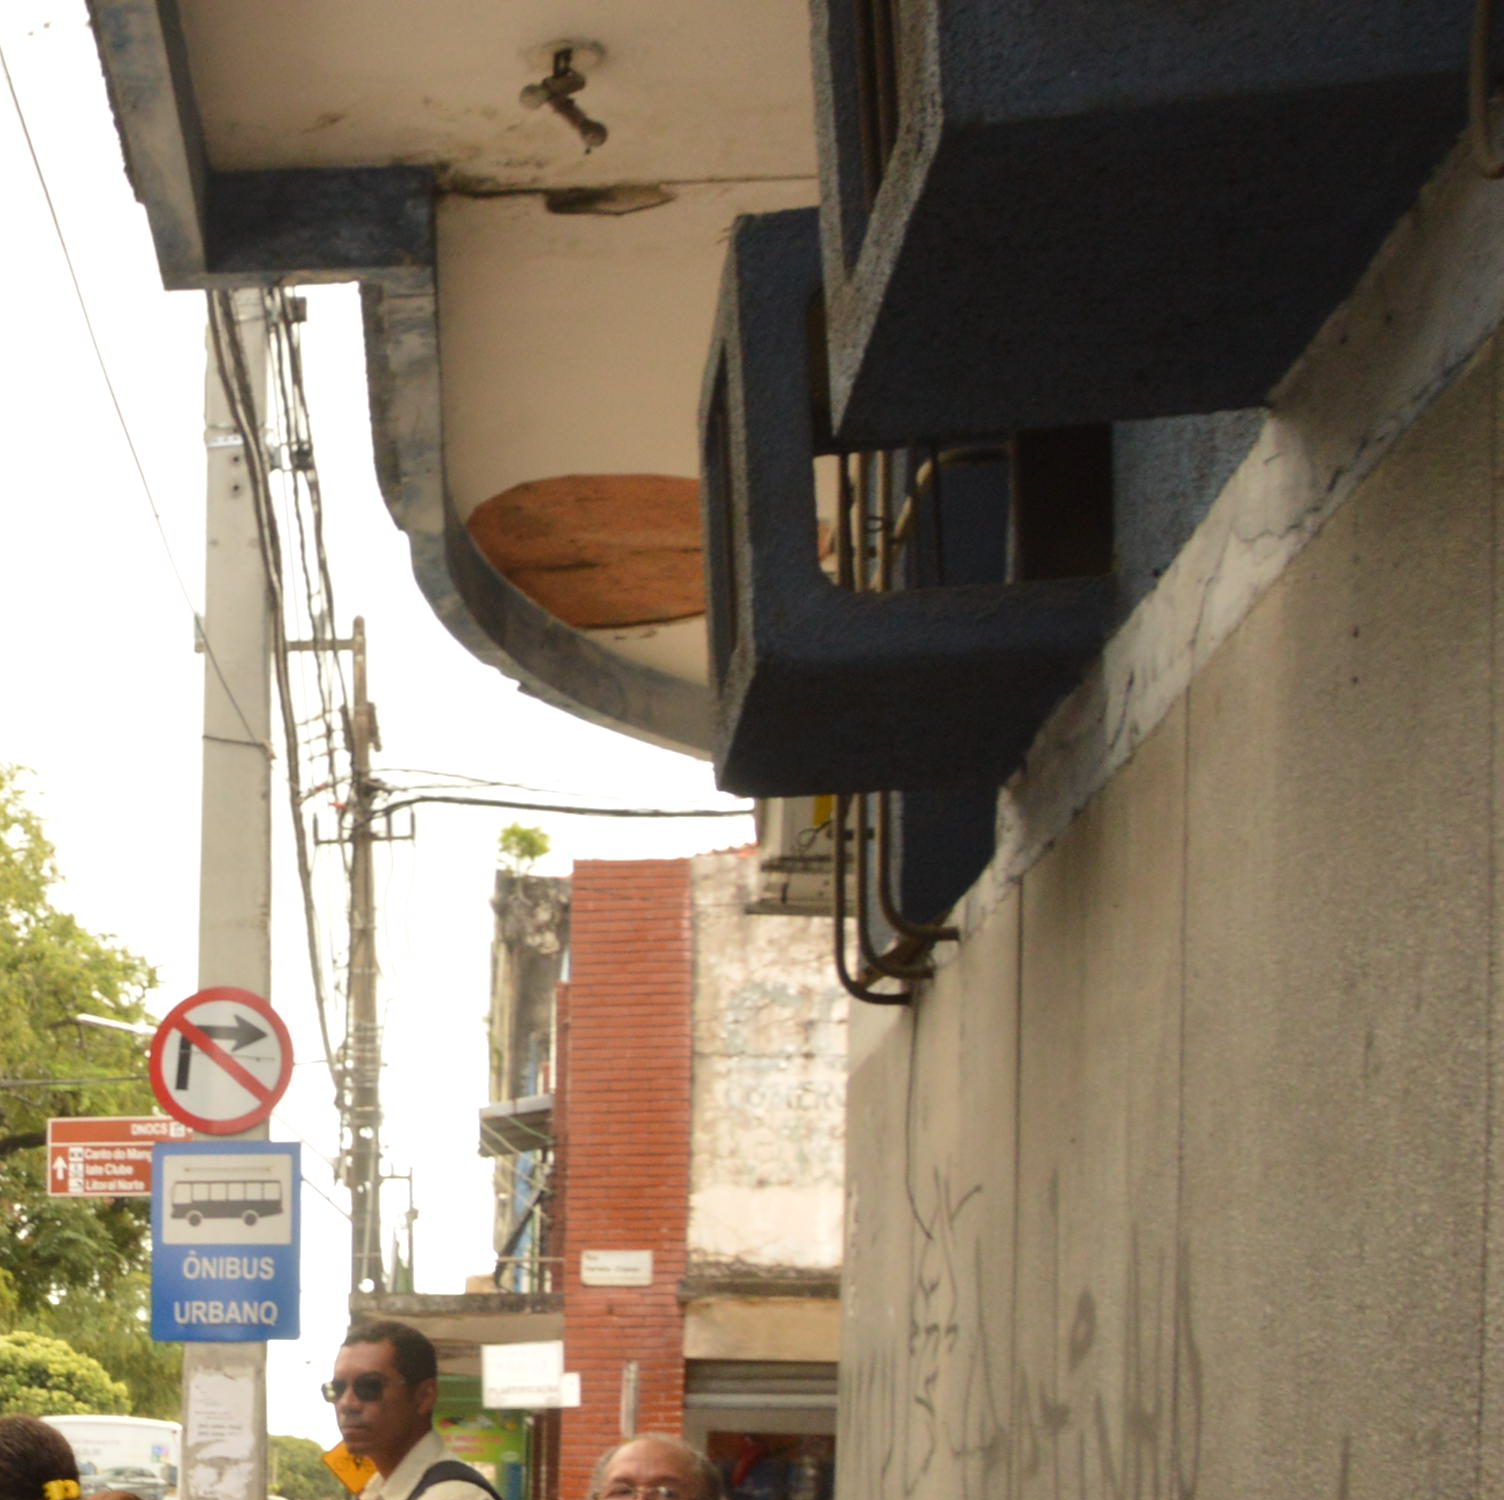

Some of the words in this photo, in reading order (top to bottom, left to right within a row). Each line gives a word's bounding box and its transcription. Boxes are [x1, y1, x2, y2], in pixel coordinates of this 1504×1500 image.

[104, 1162, 134, 1176] Clube
[117, 1179, 145, 1191] Norte
[183, 1250, 275, 1280] ÔNIBUS
[174, 1301, 278, 1326] URBANO
